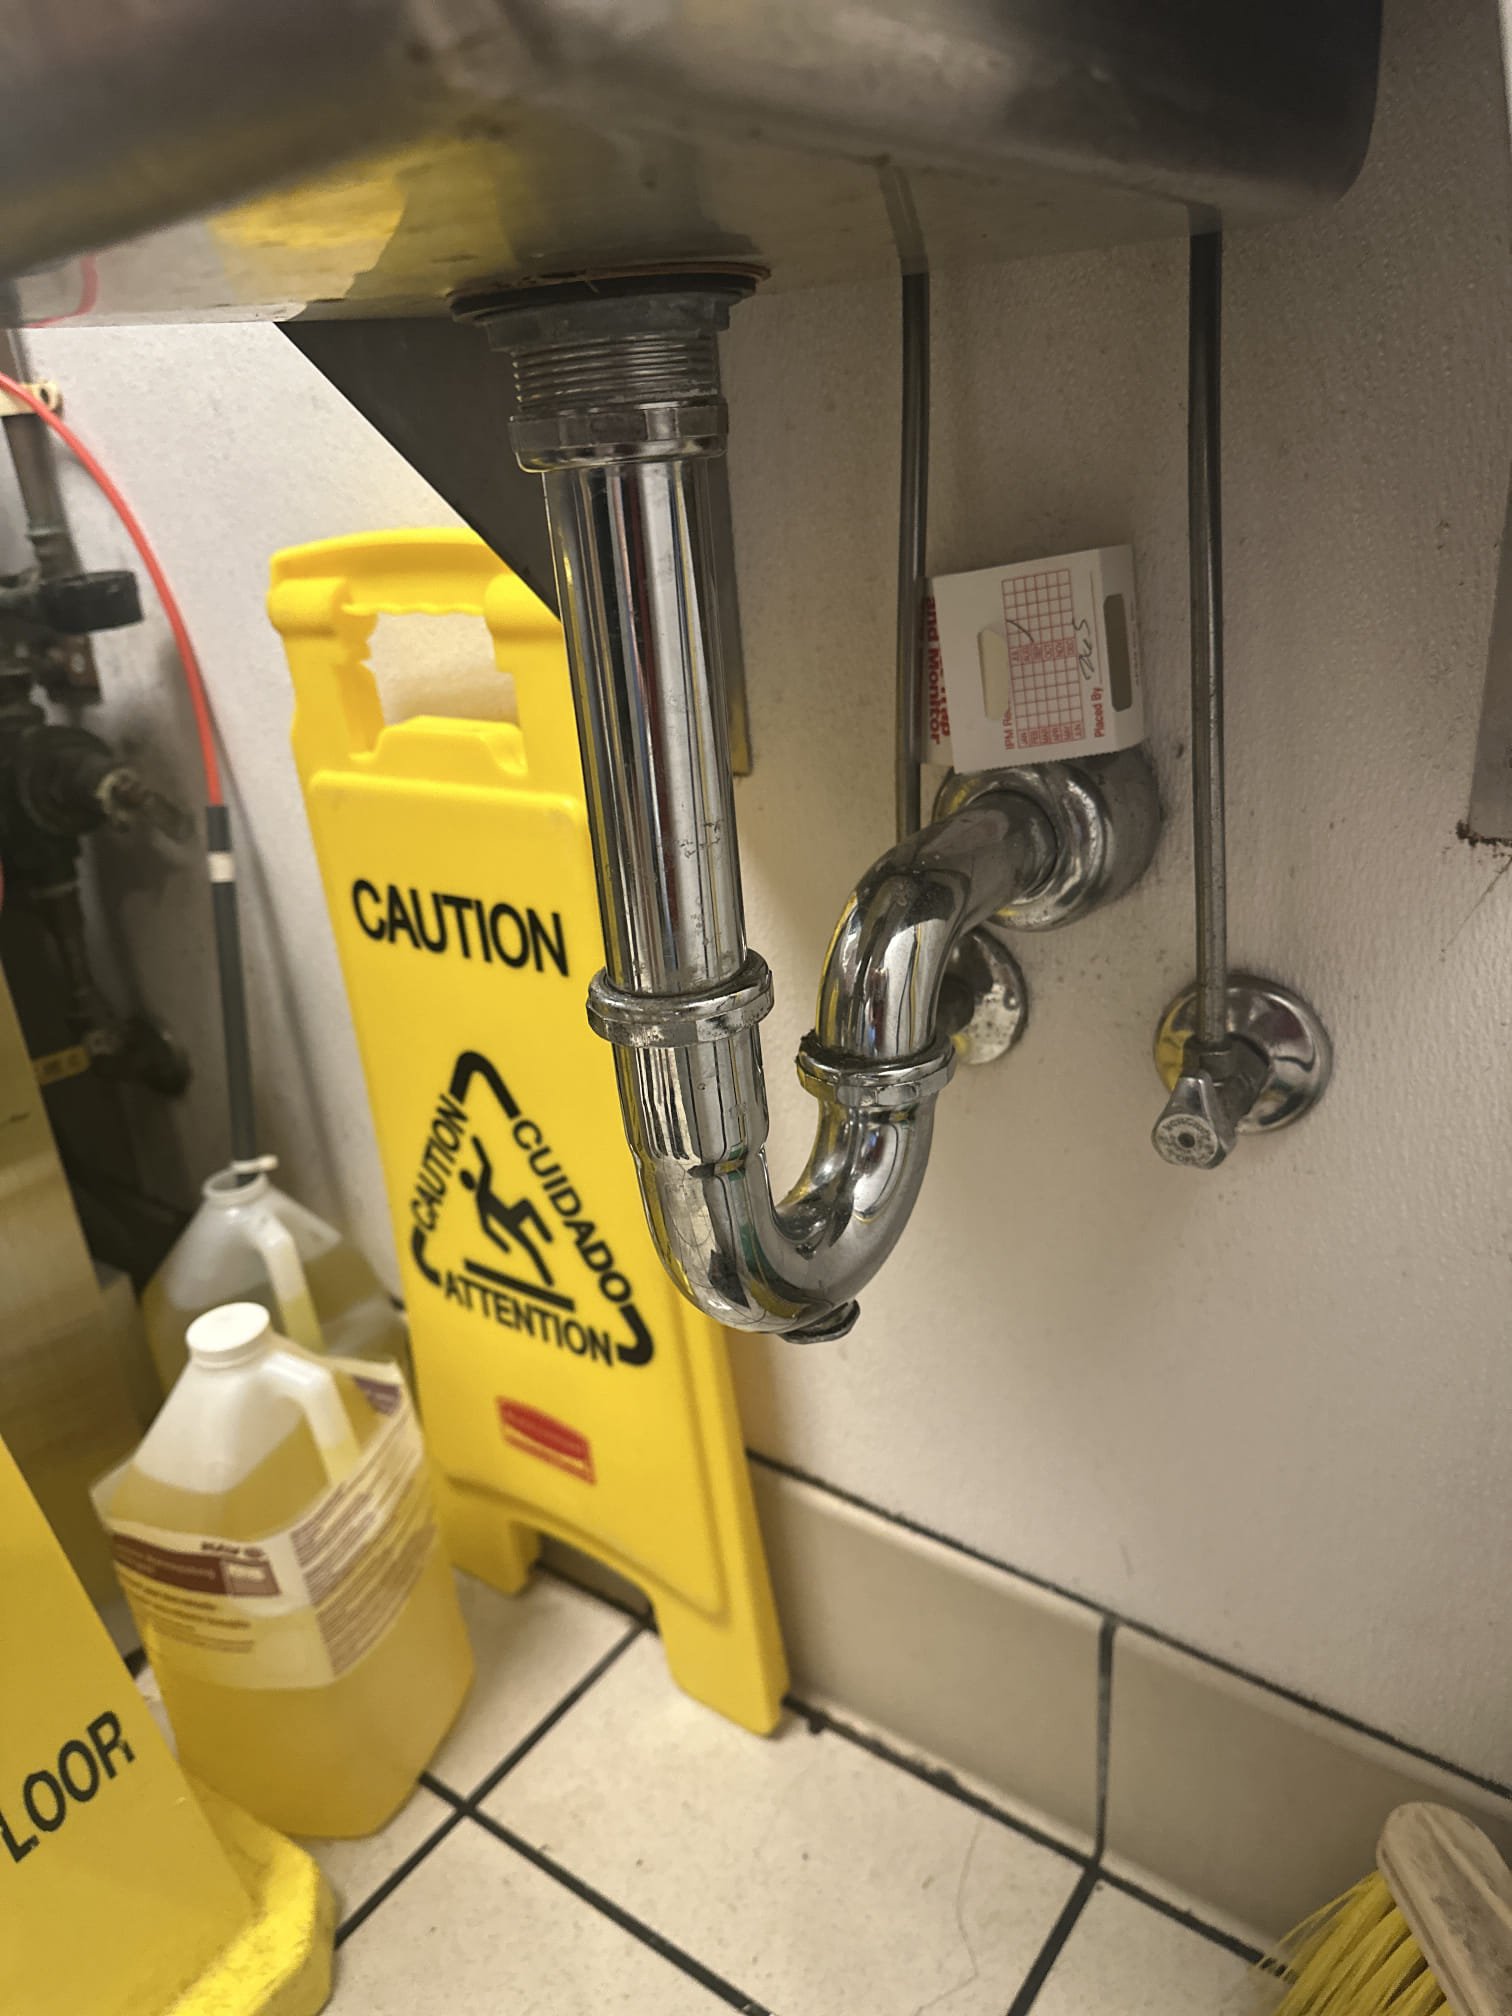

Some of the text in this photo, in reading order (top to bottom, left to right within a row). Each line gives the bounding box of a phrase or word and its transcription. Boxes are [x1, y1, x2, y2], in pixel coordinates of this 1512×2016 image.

[929, 648, 940, 745] Monitor
[1003, 730, 1014, 750] IPM
[1090, 687, 1105, 738] Placed By
[352, 878, 569, 977] CAUTION
[410, 1093, 468, 1231] CAUTION
[512, 1119, 632, 1304] CUIDADO
[444, 1270, 614, 1367] ATTENTION
